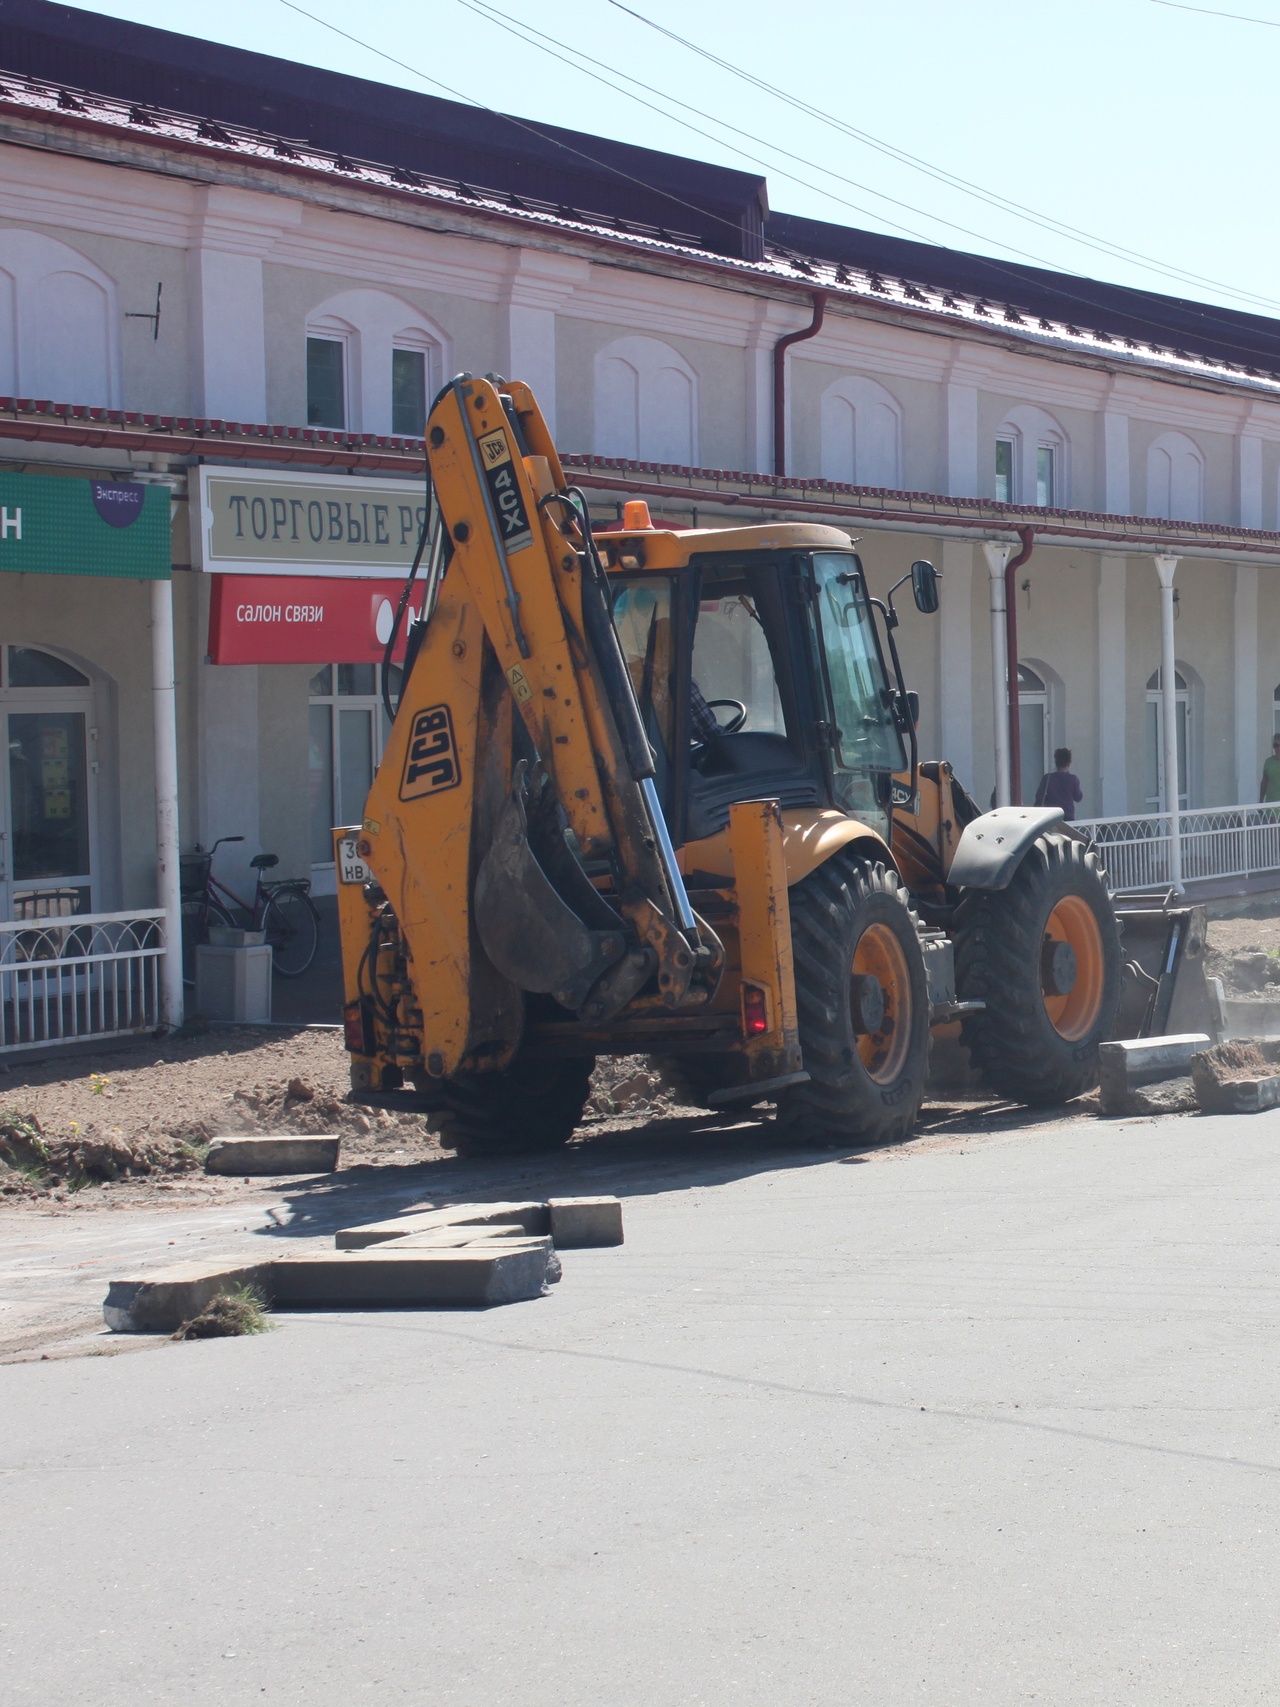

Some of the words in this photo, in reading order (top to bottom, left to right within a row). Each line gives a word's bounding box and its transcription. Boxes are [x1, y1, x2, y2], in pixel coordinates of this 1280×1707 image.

[486, 441, 505, 460] JCB
[96, 486, 139, 504] Экспресс
[494, 469, 525, 533] 4CX
[228, 495, 390, 545] ТОРГОВЫЕ
[397, 505, 441, 546] РЯ
[236, 604, 281, 622] салон
[285, 605, 324, 623] связи
[406, 710, 454, 786] JCB
